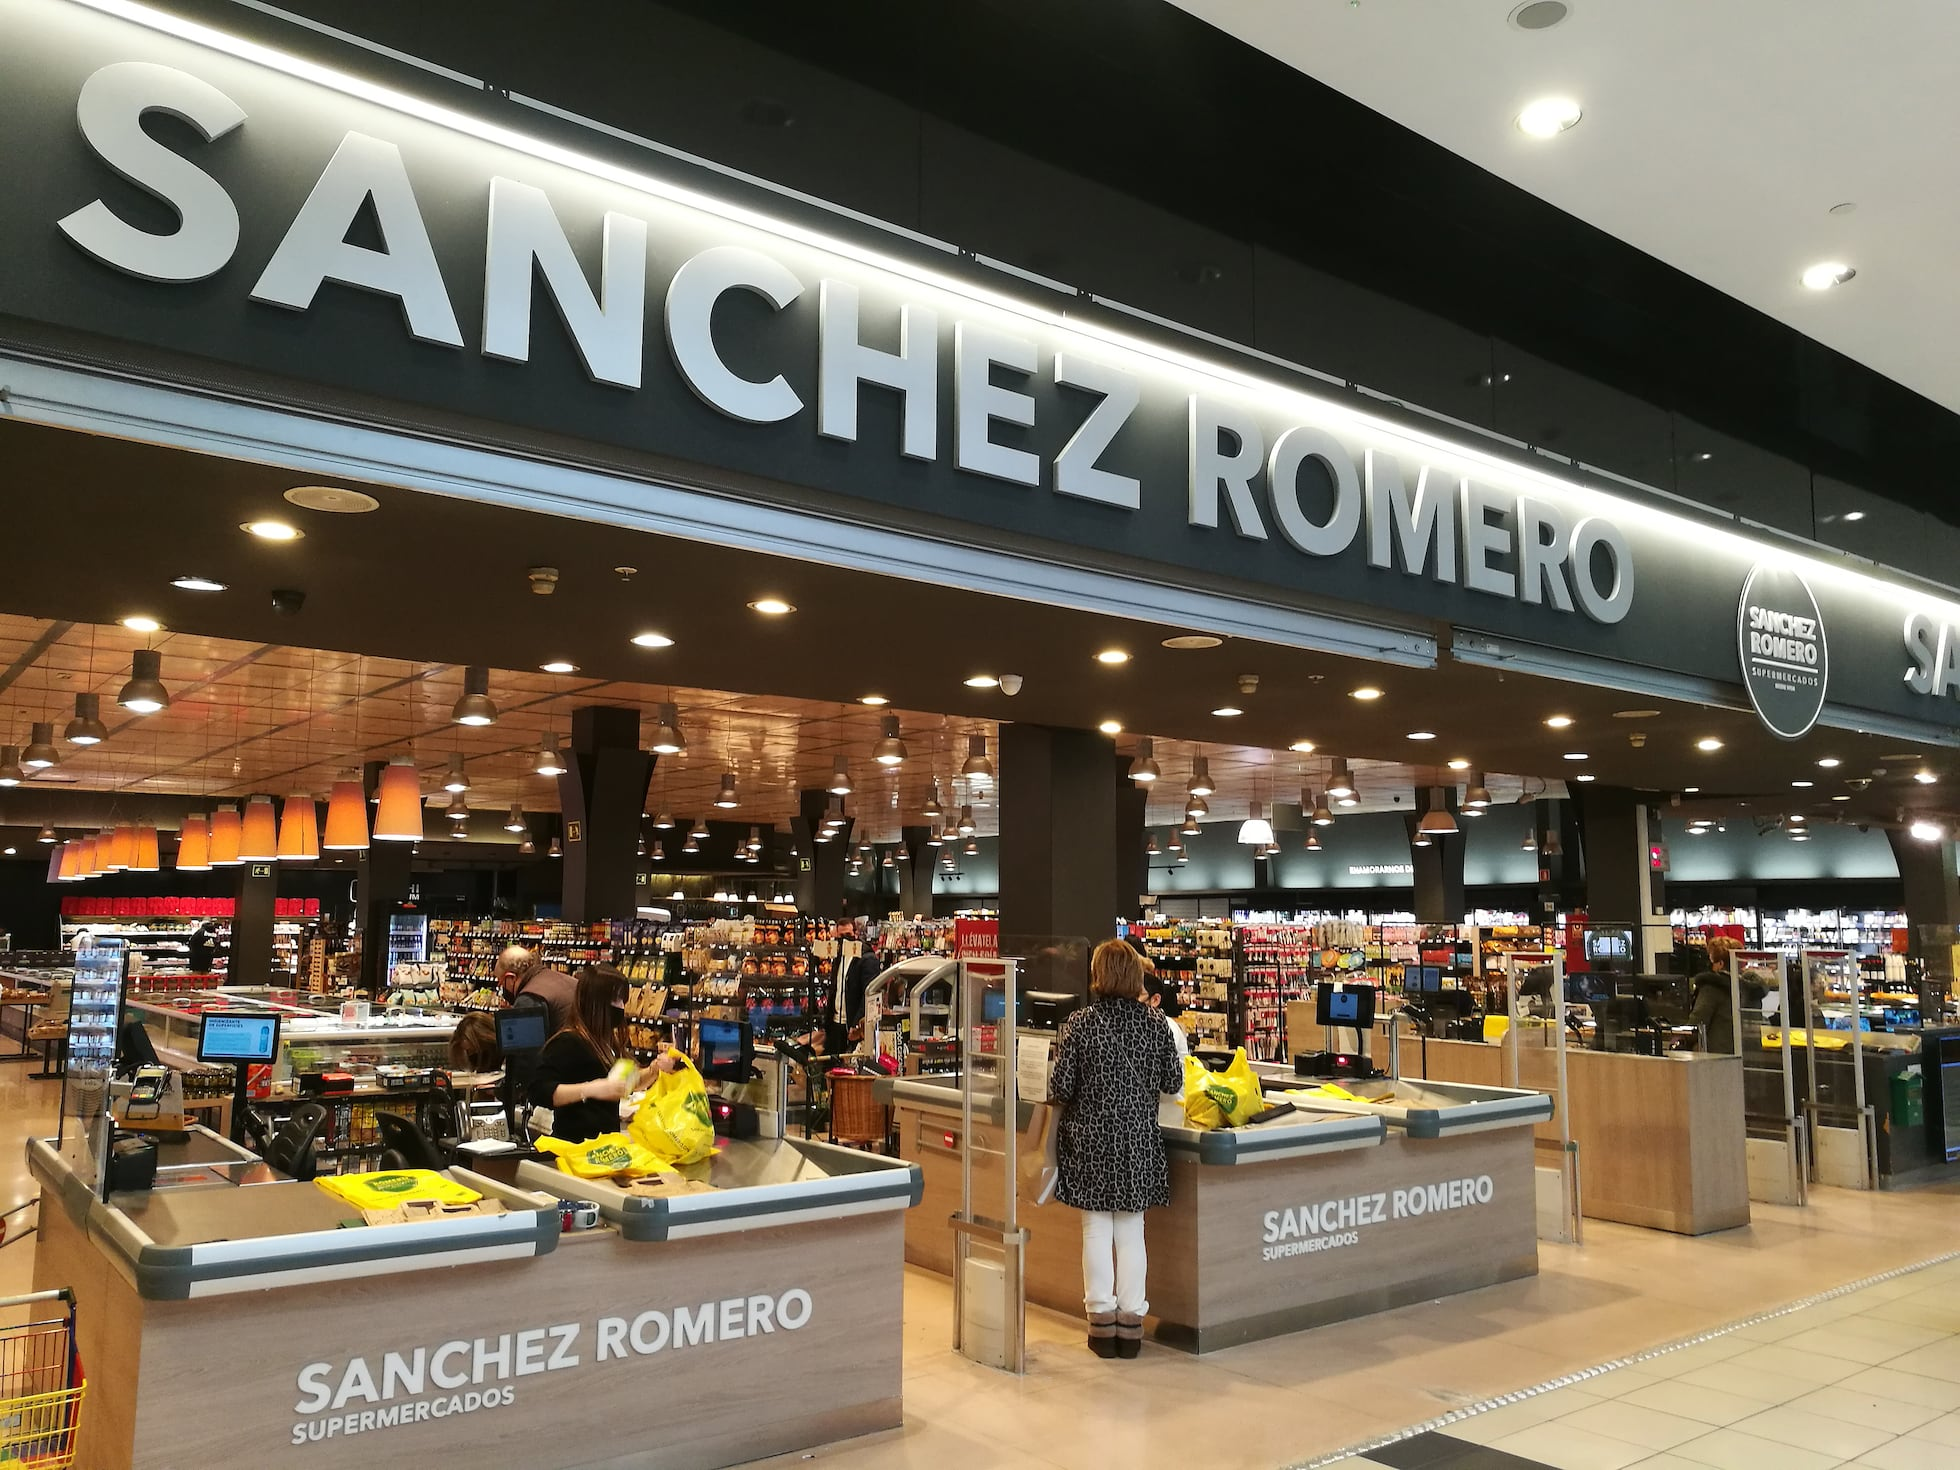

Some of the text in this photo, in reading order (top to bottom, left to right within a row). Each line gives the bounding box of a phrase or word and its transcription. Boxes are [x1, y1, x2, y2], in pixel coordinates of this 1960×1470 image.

[57, 61, 1635, 625] SANCHEZ ROMERO
[1749, 606, 1817, 641] SANCHEZ
[1750, 631, 1818, 665] ROMERO
[1752, 667, 1818, 687] SUPERMERCADOS
[1262, 1175, 1494, 1243] SANCHEZ ROMERO
[1262, 1231, 1359, 1261] SUPERMERCADOS
[293, 1287, 814, 1415] SANCHEZ ROMERO
[291, 1384, 516, 1446] SUPERMERCADOS
